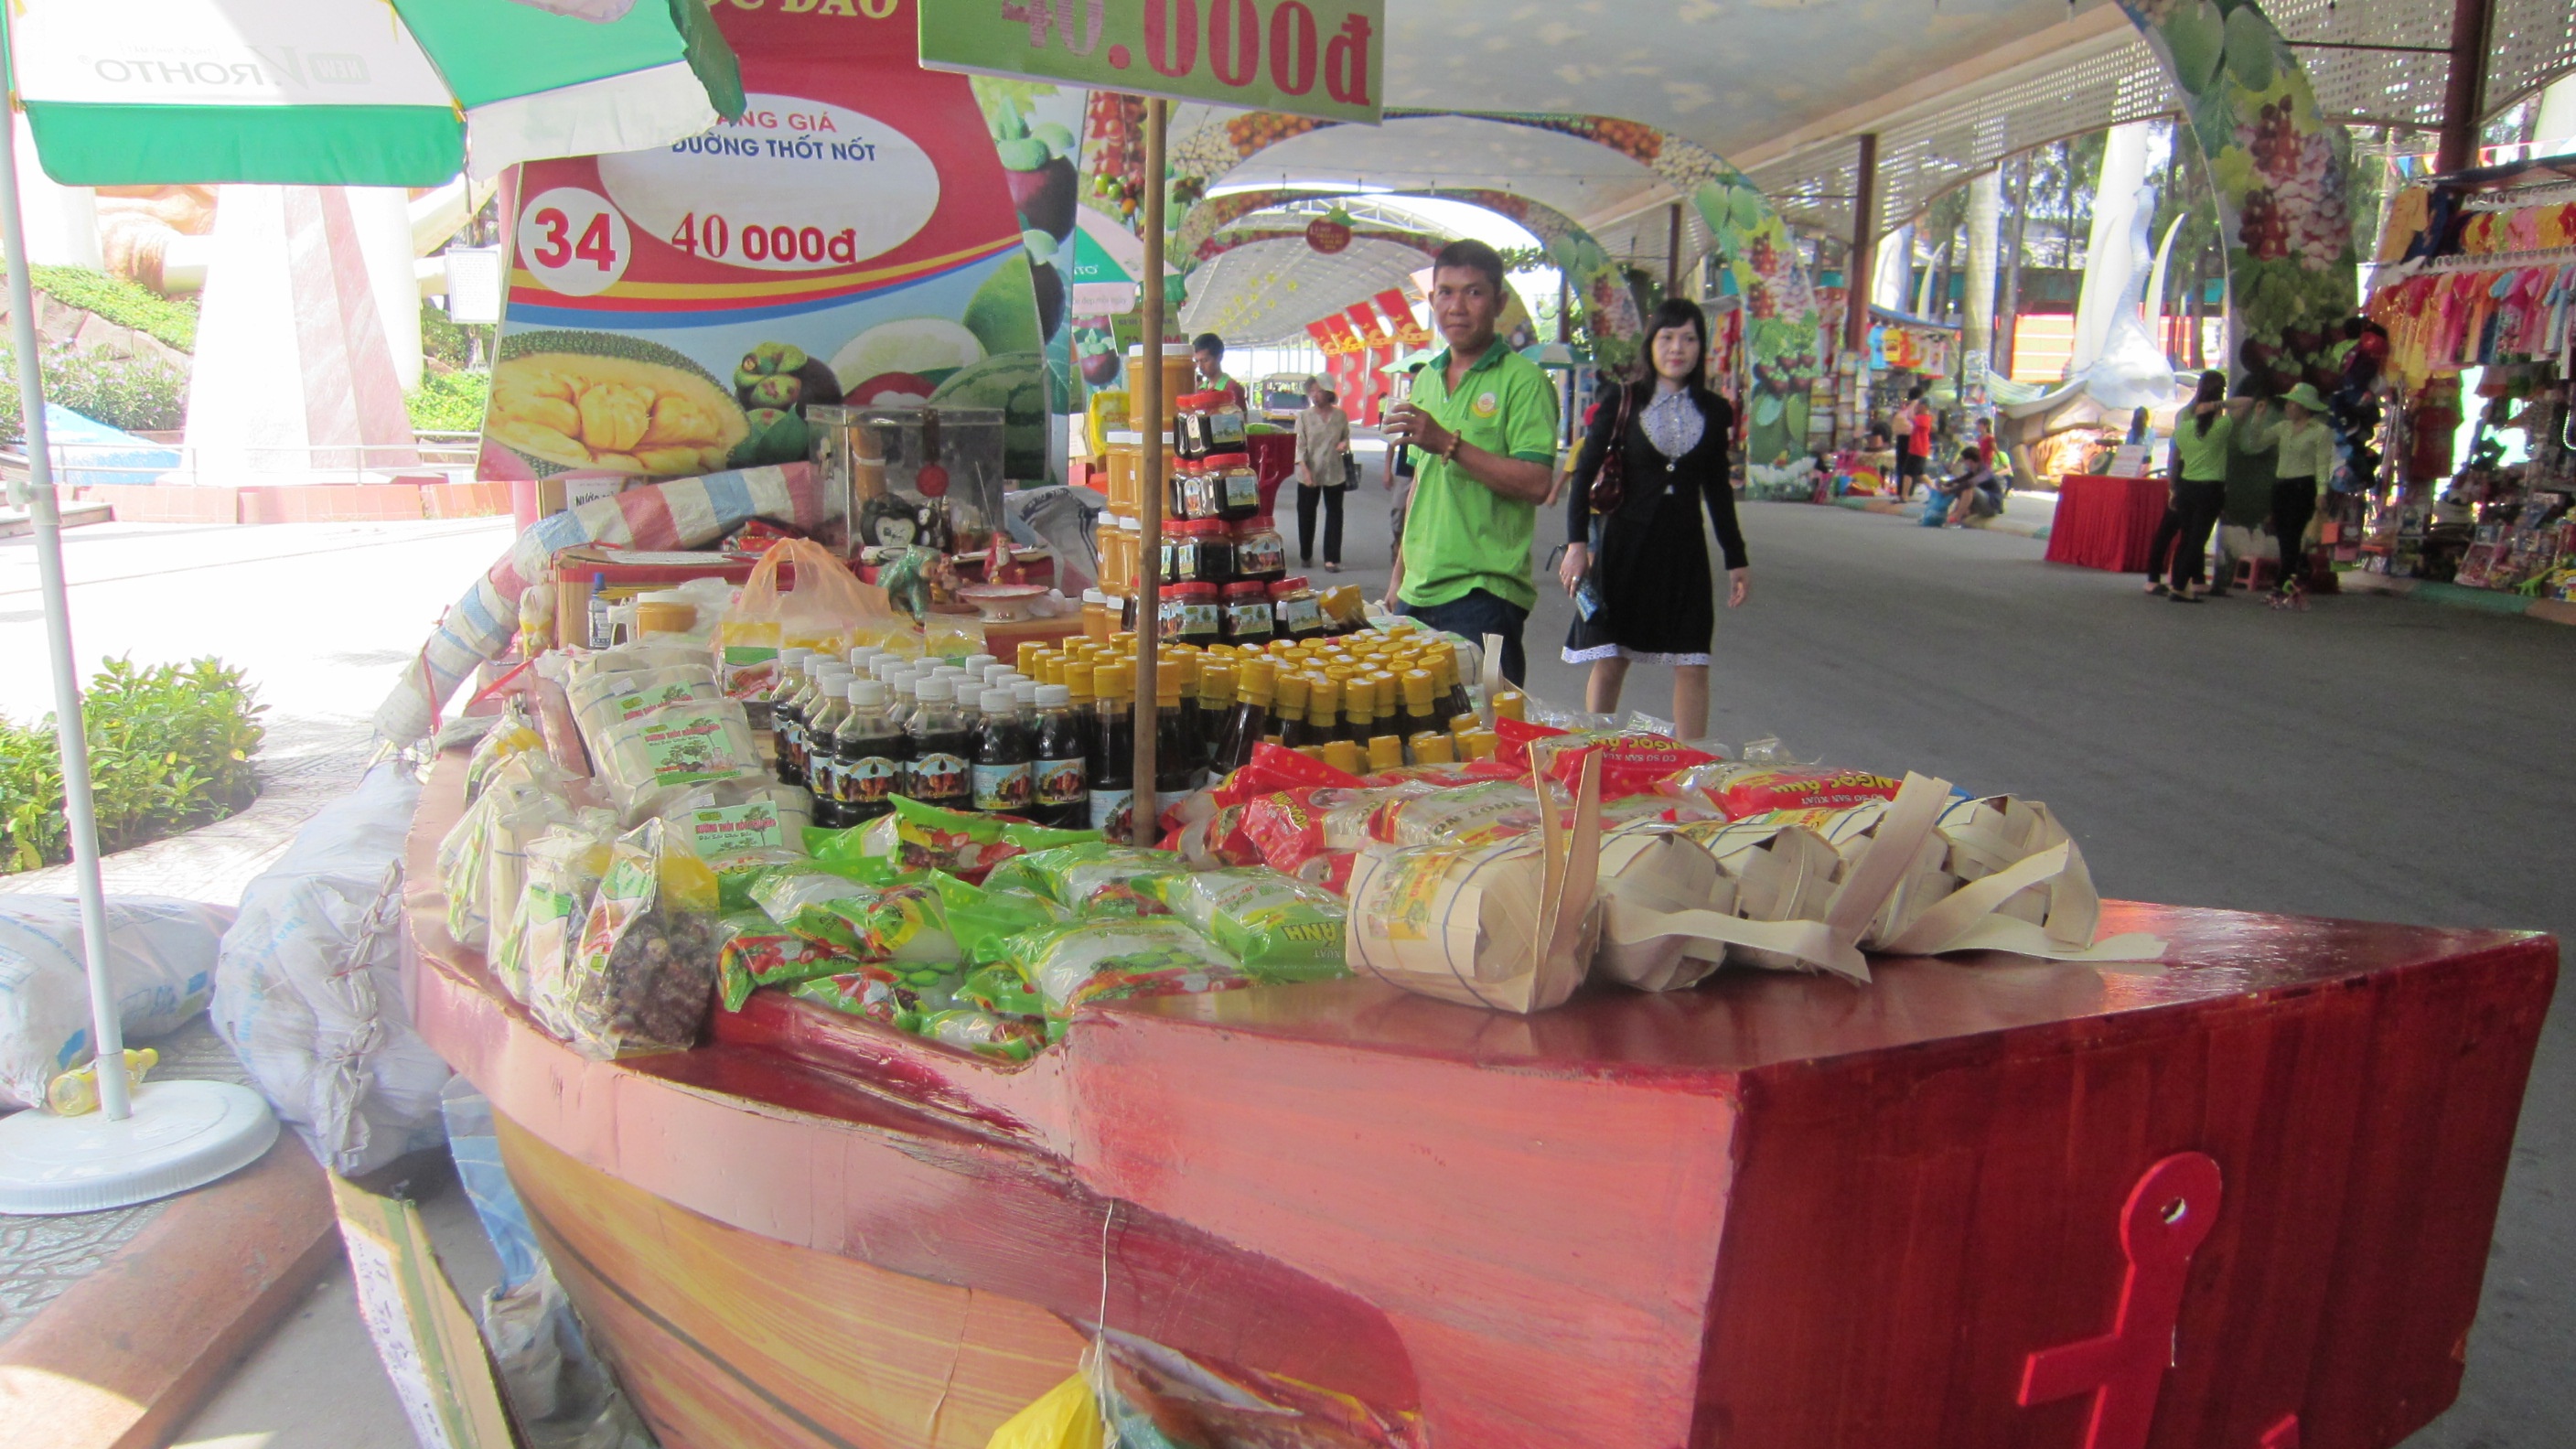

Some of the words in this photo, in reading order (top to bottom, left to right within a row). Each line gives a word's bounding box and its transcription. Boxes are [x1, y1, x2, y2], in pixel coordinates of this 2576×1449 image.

[788, 111, 837, 133] GIÁ
[765, 134, 824, 159] THỐT
[832, 136, 876, 162] NỐT
[533, 207, 617, 273] 34
[671, 212, 730, 259] 40
